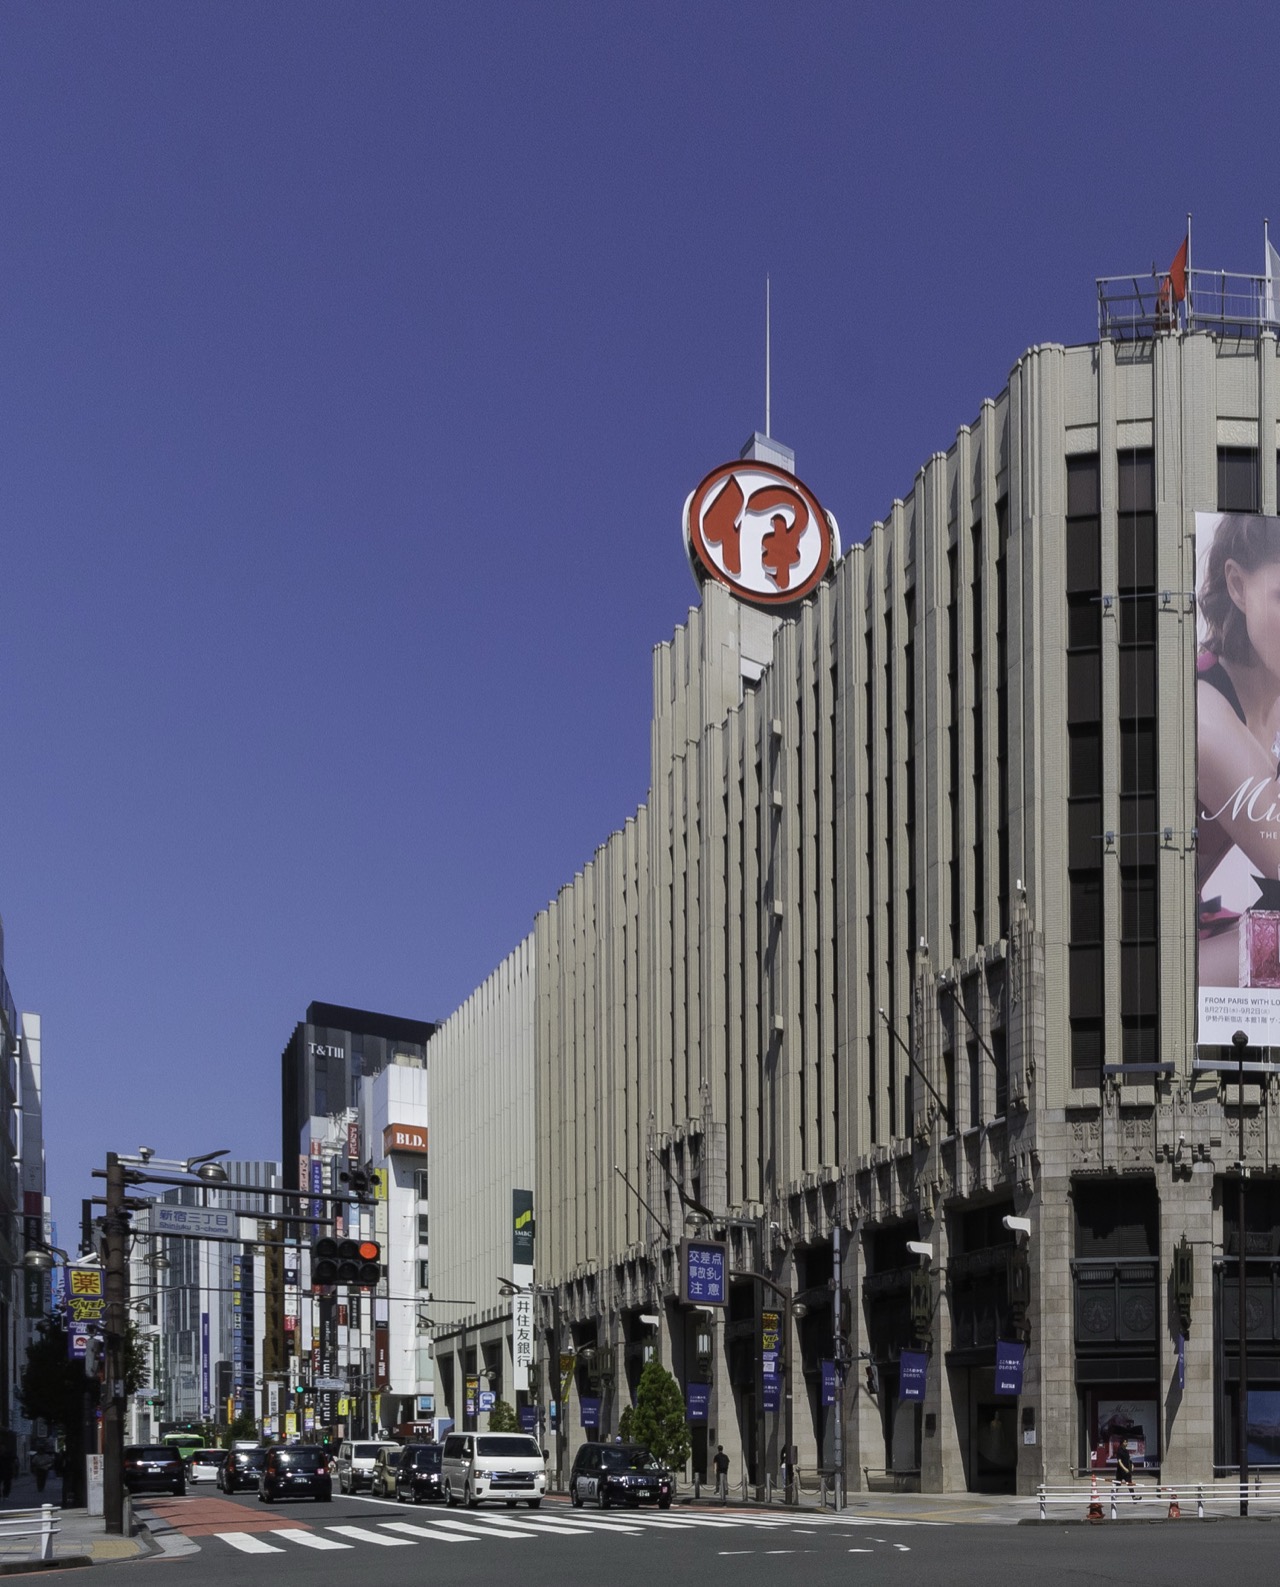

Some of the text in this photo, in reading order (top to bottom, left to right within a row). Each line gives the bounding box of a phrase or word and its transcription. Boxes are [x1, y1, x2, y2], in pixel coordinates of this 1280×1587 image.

[1259, 831, 1278, 840] THE
[1204, 996, 1226, 1004] FROM
[1227, 997, 1249, 1005] PARIS
[395, 1131, 426, 1148] BLD.
[159, 1209, 228, 1226] 新宿三丁目
[159, 1221, 229, 1234] Shinjuku 3-chome
[688, 1250, 722, 1265] 交差点
[688, 1265, 722, 1281] 事故多し
[72, 1271, 101, 1294] 薬
[690, 1281, 720, 1296] 注意
[68, 1298, 106, 1311] マツモト
